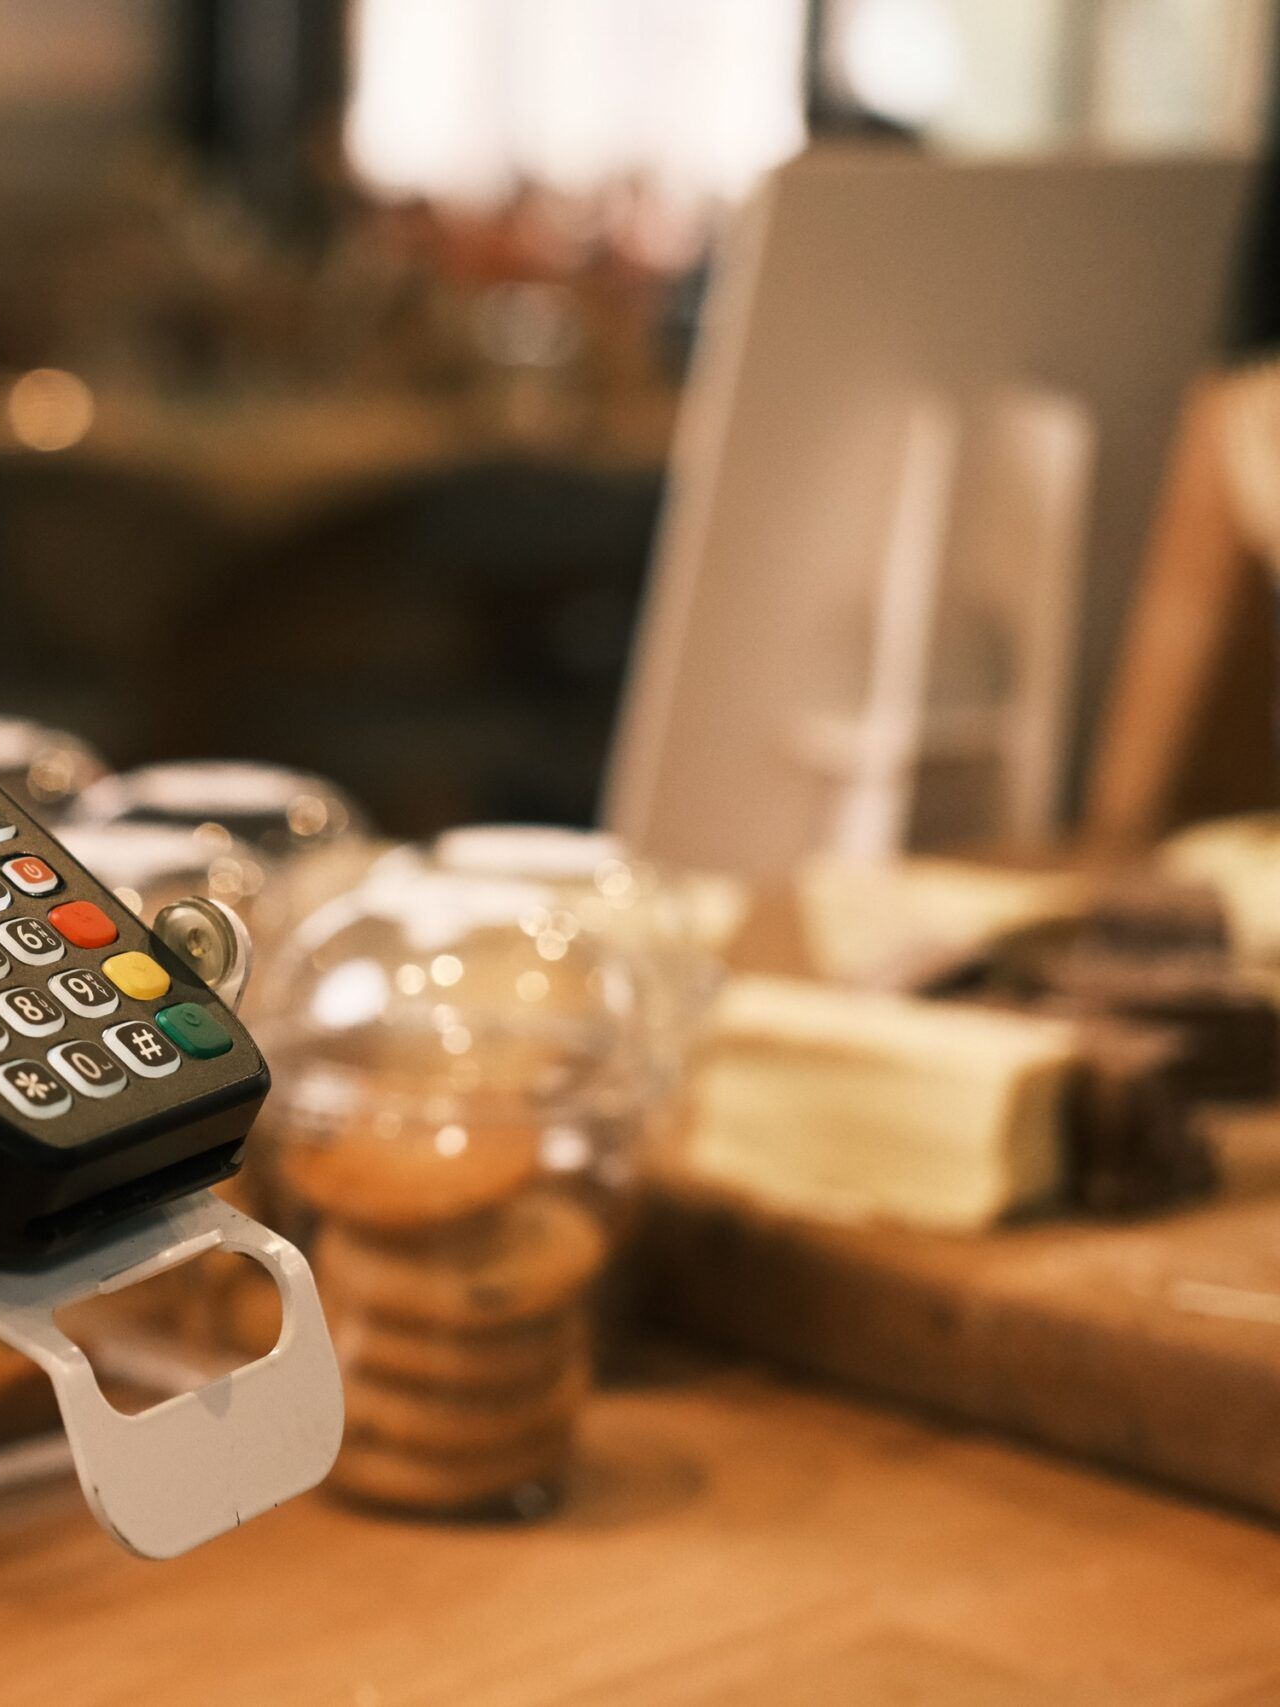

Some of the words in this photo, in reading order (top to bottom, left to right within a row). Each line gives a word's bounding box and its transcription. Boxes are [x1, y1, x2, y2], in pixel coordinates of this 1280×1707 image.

[16, 925, 43, 950] 6
[29, 921, 57, 946] MNO
[67, 977, 95, 1002] 9
[82, 972, 110, 998] WXY
[13, 996, 44, 1021] 8
[29, 991, 56, 1017] TUV
[71, 1052, 102, 1080] 0
